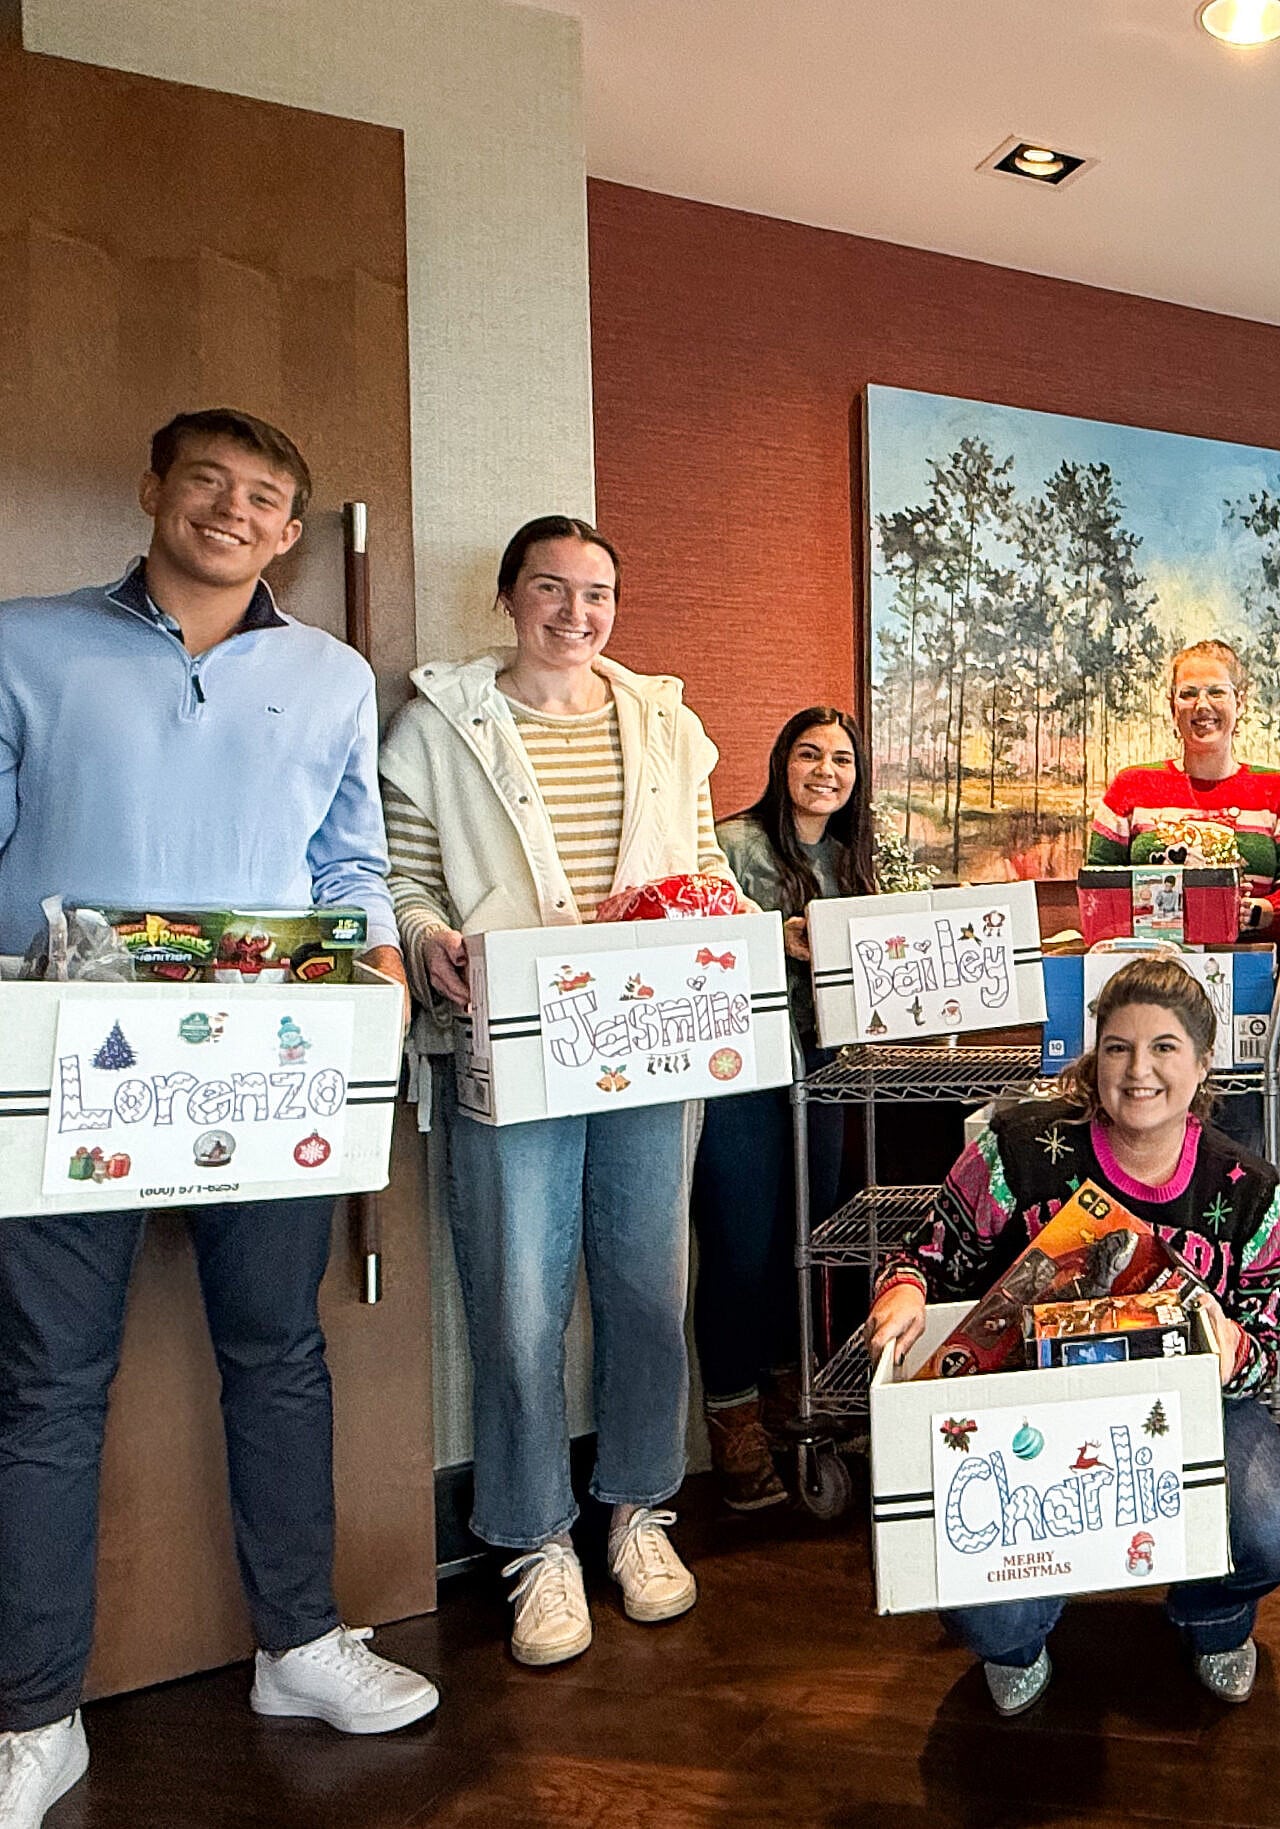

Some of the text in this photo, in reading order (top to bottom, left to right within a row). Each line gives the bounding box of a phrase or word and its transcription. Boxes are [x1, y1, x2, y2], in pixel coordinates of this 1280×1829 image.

[855, 918, 1011, 1009] Bailey
[543, 979, 750, 1068] Jasmine
[1051, 1043, 1062, 1051] 10
[58, 1054, 346, 1134] Lorenzo
[946, 1425, 1181, 1554] Charlie
[987, 1562, 1072, 1583] CHRISTMAS
[1003, 1550, 1055, 1567] MERRY
